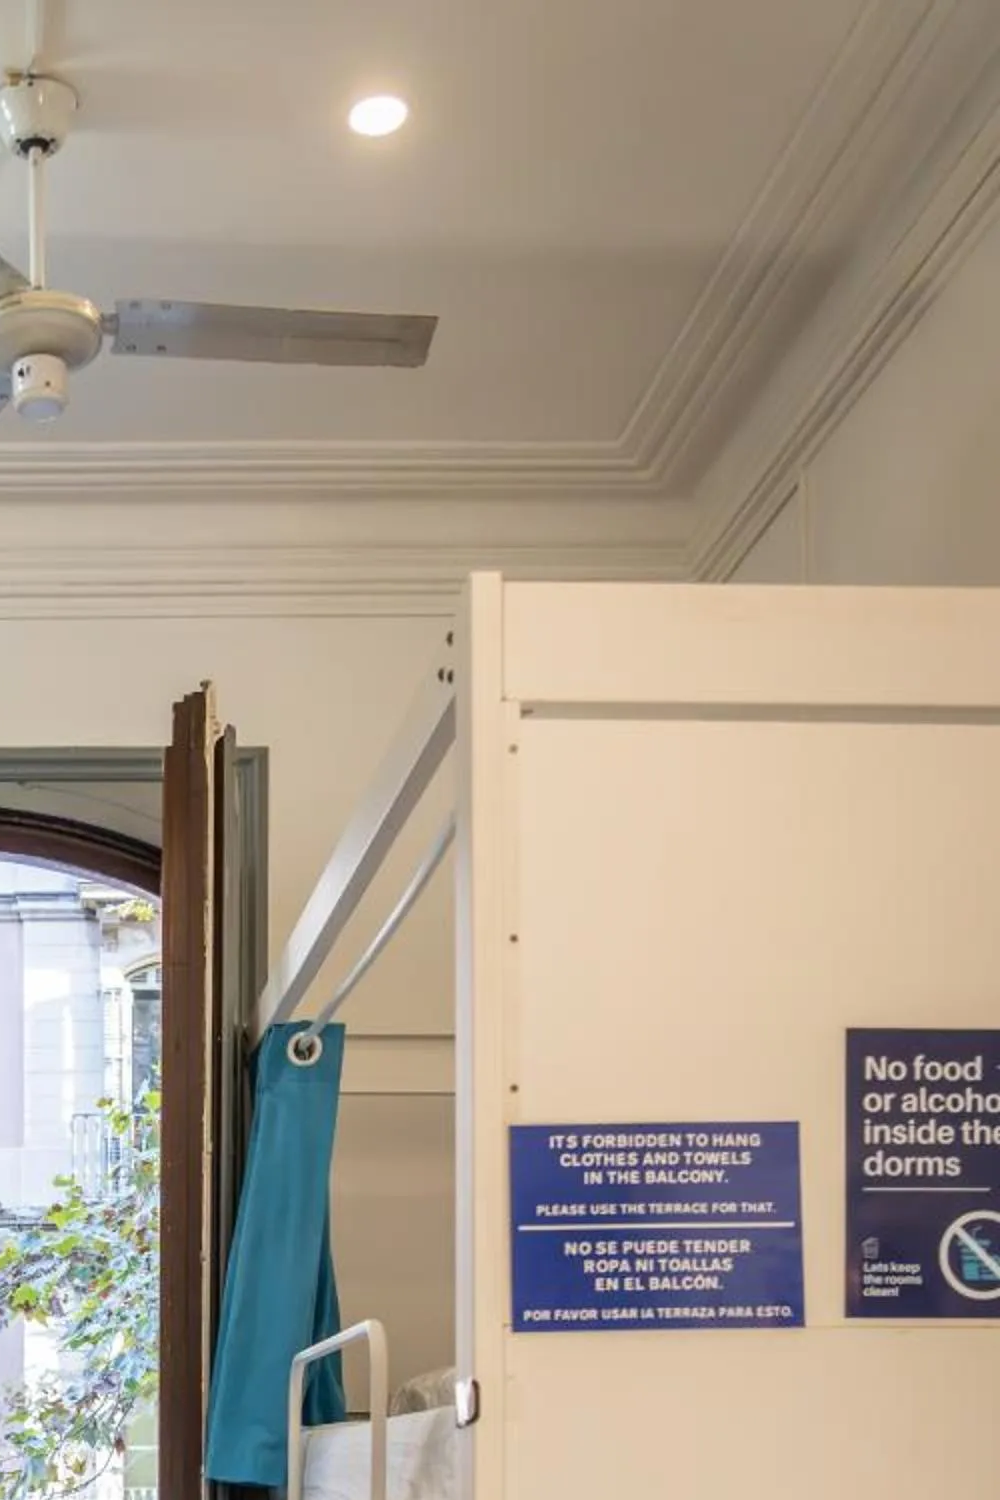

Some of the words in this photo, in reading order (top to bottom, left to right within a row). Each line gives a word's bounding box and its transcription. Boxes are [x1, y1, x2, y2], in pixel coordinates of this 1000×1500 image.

[864, 1055, 907, 1081] No
[913, 1054, 983, 1081] food
[862, 1092, 896, 1113] or
[863, 1119, 955, 1145] inside
[548, 1135, 577, 1149] ITS
[582, 1133, 681, 1148] FORBIDDEN
[686, 1133, 709, 1147] TO
[711, 1132, 762, 1147] HANG
[559, 1152, 639, 1167] CLOTHES
[642, 1152, 680, 1166] AND
[683, 1151, 752, 1165] TOWELS
[863, 1150, 961, 1176] dorms
[583, 1171, 603, 1185] IN
[606, 1170, 640, 1185] THE
[645, 1169, 729, 1184] BALCONY.
[535, 1204, 587, 1216] PLEASE
[589, 1203, 617, 1215] USE
[620, 1203, 645, 1214] THE
[648, 1202, 708, 1214] TERRACE
[711, 1202, 738, 1213] FOR
[564, 1241, 592, 1256] NO
[595, 1241, 618, 1255] SE
[622, 1240, 679, 1254] PUEDE
[683, 1239, 751, 1253] TENDER
[583, 1259, 631, 1273] ROPA
[635, 1258, 654, 1272] NI
[659, 1257, 733, 1272] TOALLAS
[595, 1277, 619, 1291] EN
[623, 1277, 645, 1291] EL
[553, 1309, 598, 1320] FAVOR
[657, 1307, 716, 1318] TERRAZA
[718, 1307, 754, 1318] PARA
